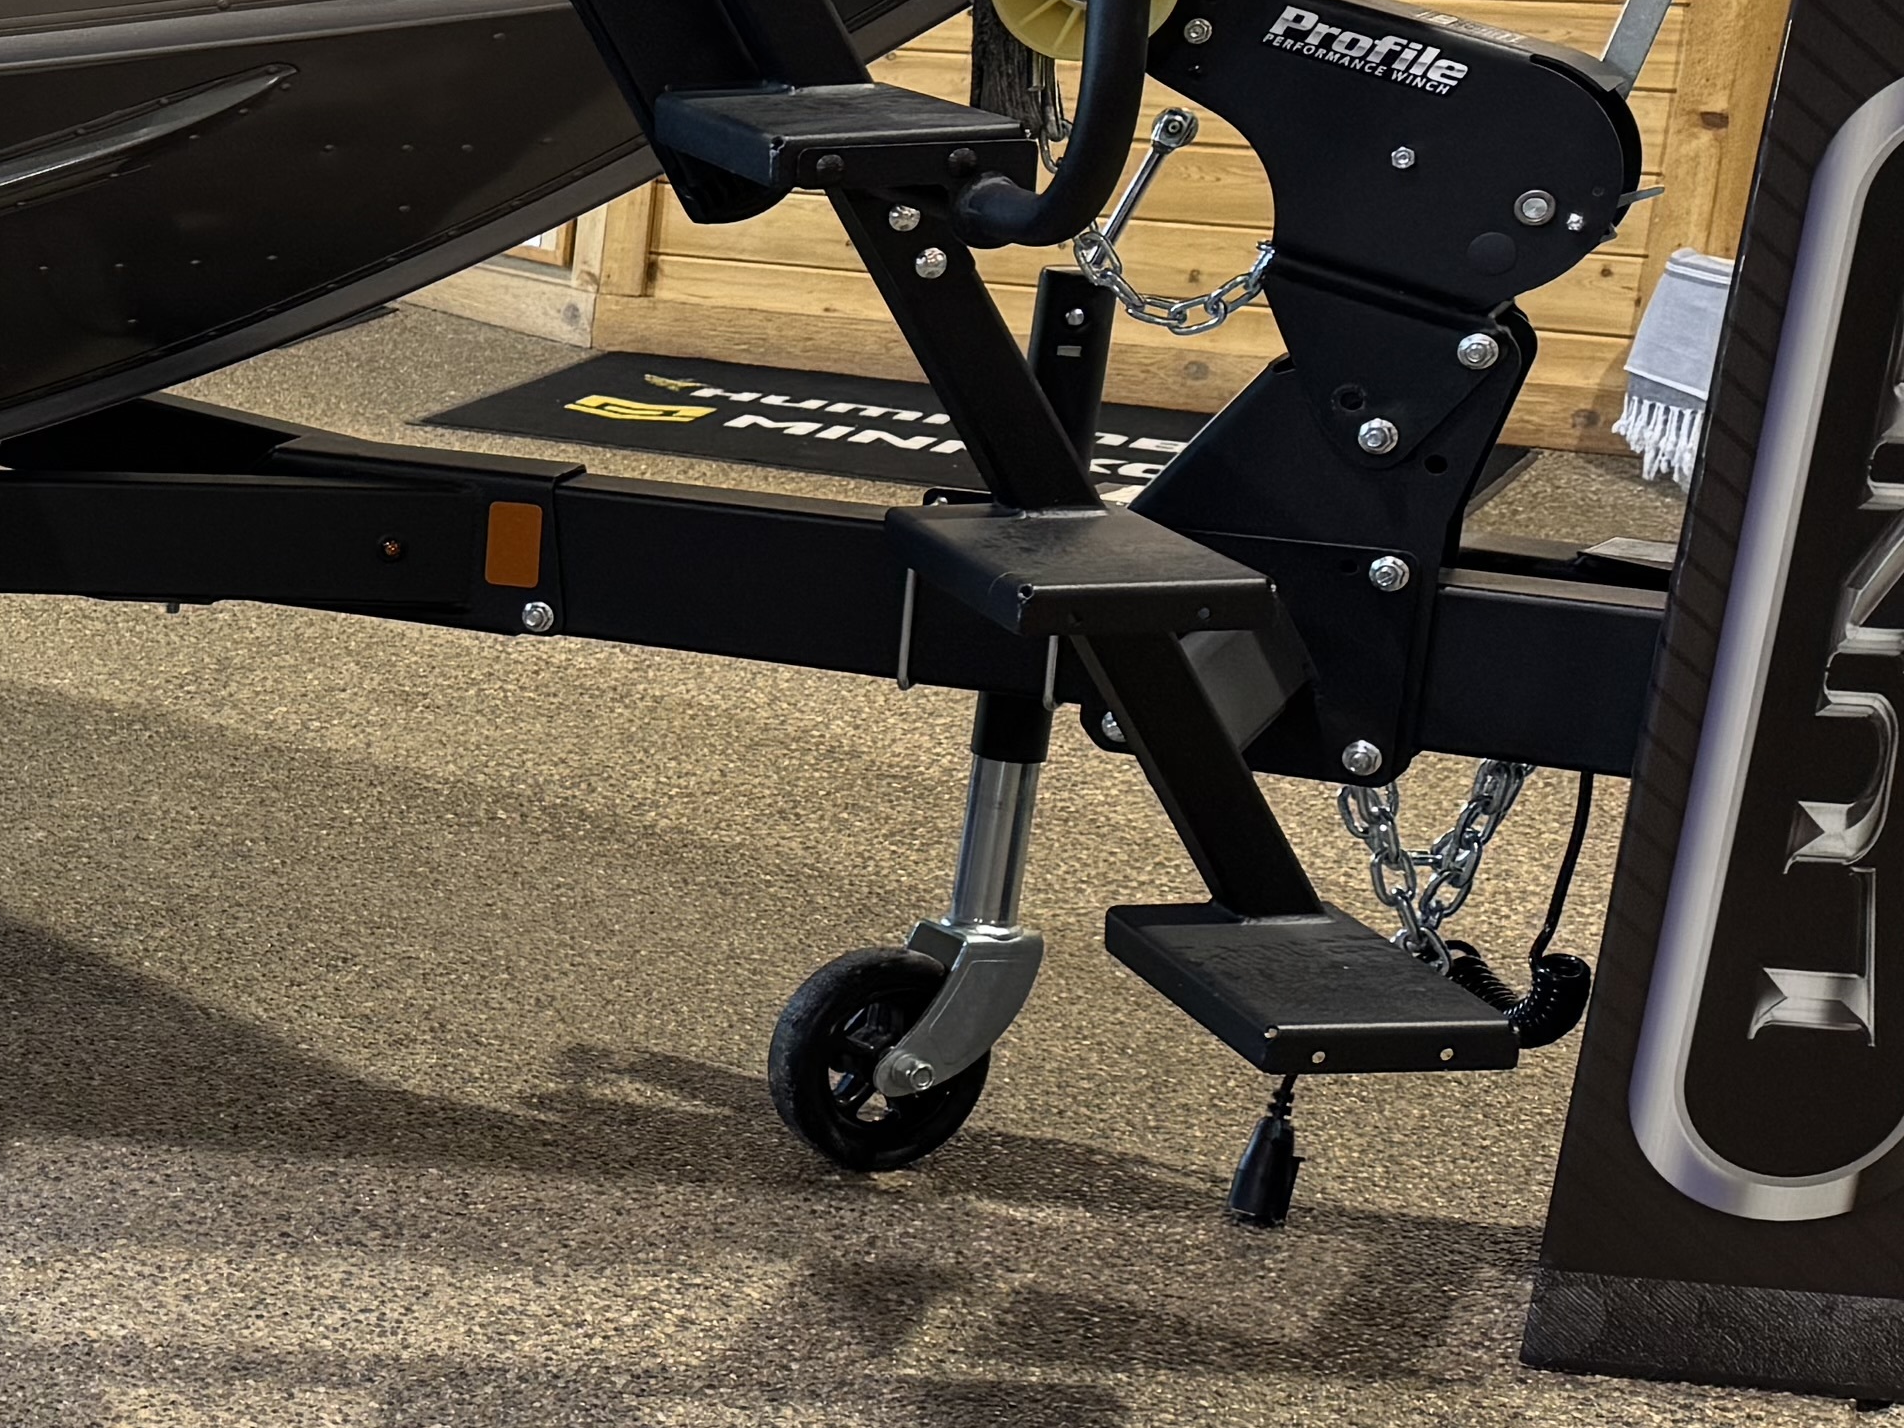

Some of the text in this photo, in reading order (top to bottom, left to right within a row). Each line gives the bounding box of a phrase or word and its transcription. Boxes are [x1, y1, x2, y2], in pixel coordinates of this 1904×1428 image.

[1262, 32, 1451, 96] PERFORMANCE WINCH
[1269, 5, 1469, 87] Profile
